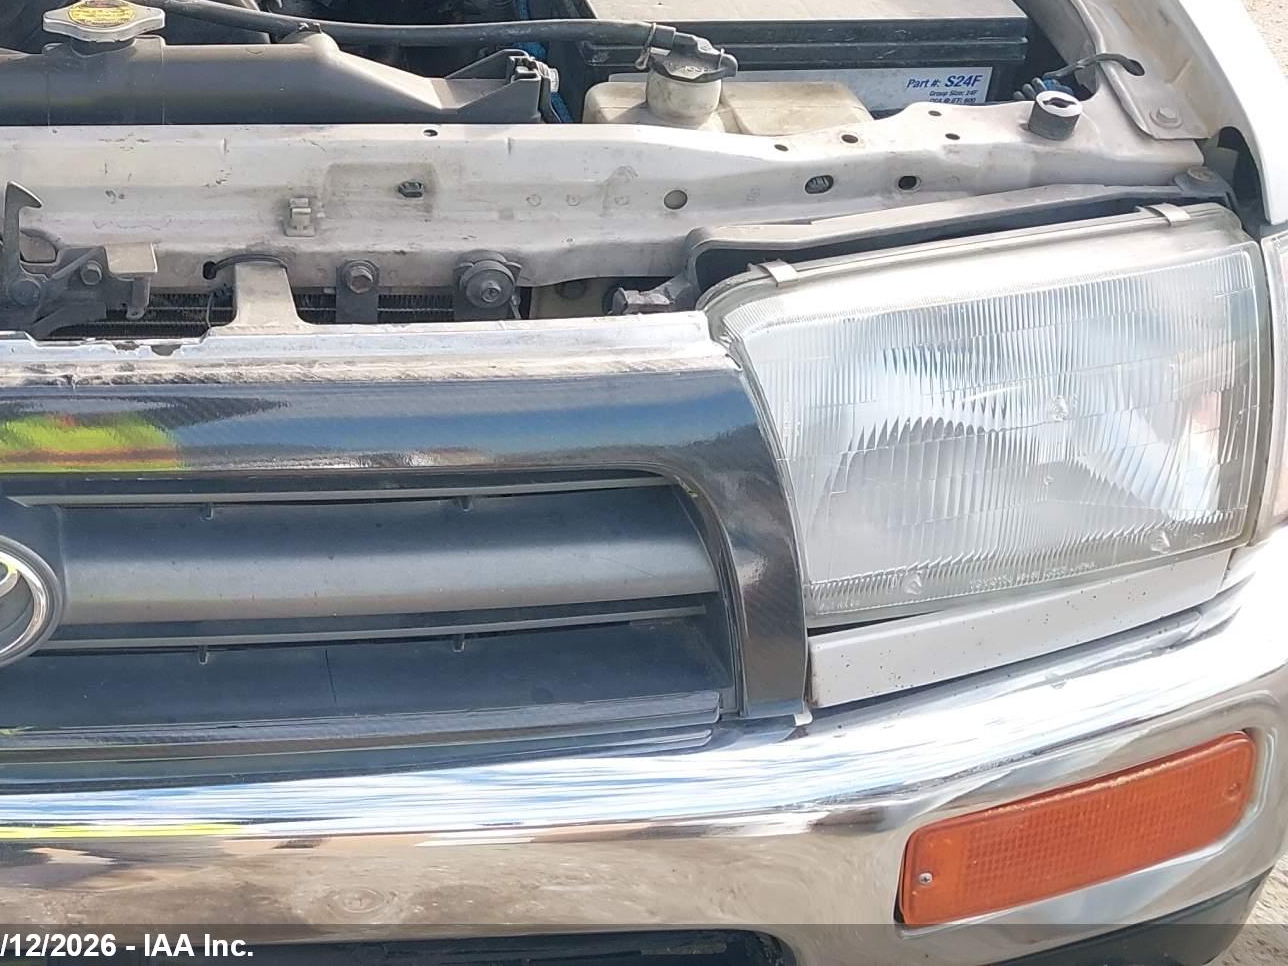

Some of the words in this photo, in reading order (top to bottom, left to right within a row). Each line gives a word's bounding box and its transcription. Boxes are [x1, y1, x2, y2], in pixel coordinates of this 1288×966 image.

[906, 78, 929, 89] Part
[931, 78, 942, 88] #:
[945, 74, 984, 88] S24F
